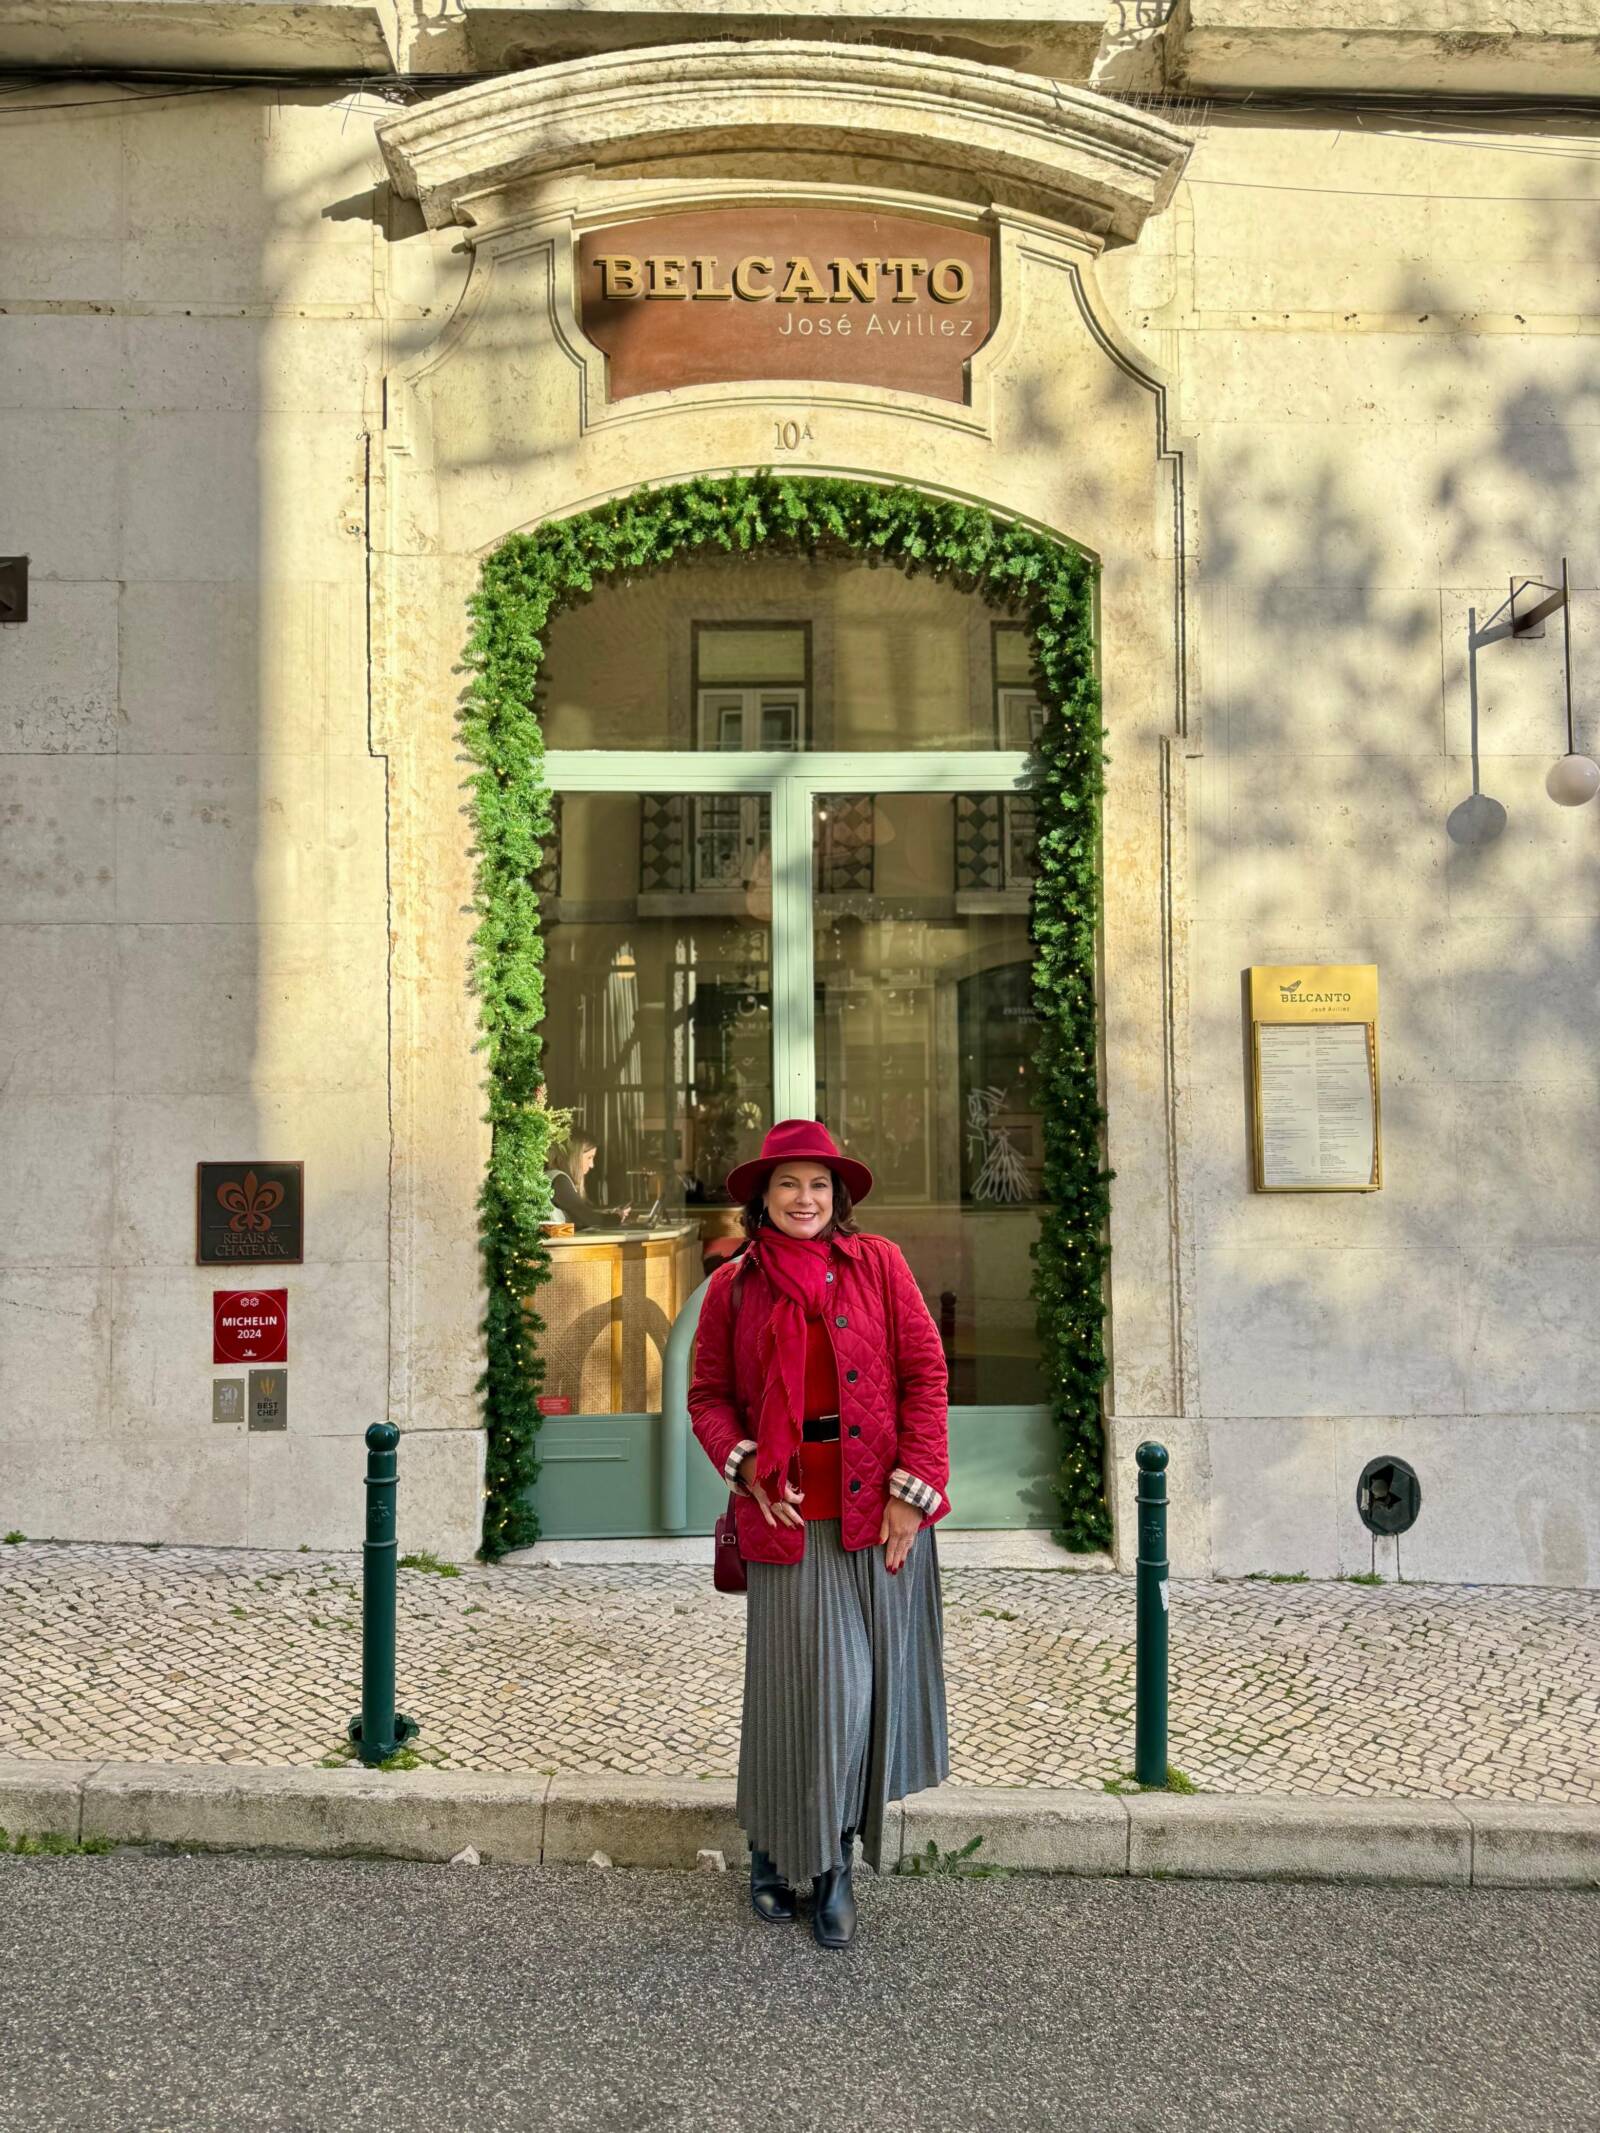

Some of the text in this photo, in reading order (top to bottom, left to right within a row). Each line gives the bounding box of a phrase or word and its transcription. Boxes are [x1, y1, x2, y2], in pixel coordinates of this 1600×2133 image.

[593, 254, 975, 304] BELCANTO
[777, 312, 974, 337] José Avillez
[1280, 993, 1351, 1003] BELCANTO
[223, 1231, 278, 1244] RELAIS &
[222, 1316, 278, 1326] MICHELIN
[237, 1329, 262, 1339] 2024
